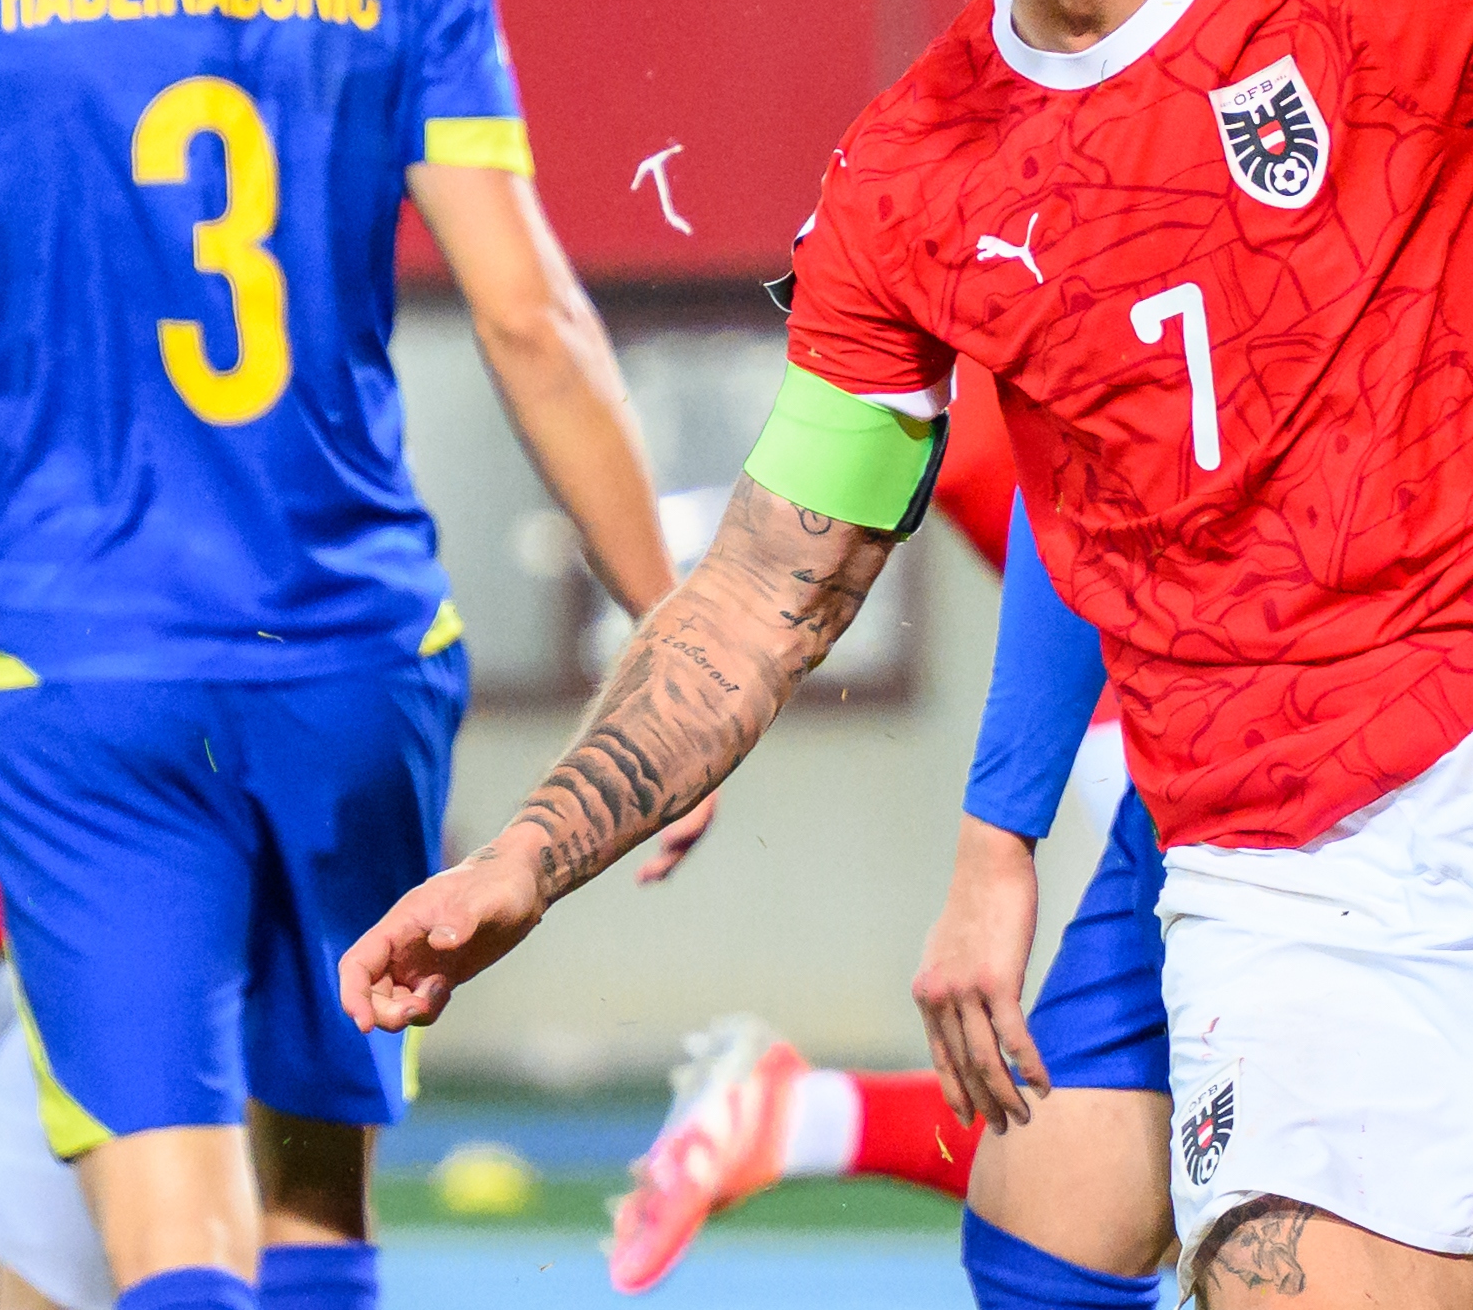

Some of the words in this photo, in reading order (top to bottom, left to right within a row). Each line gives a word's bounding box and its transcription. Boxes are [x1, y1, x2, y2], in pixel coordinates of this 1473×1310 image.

[1233, 79, 1274, 106] ÖFB
[132, 75, 293, 427] 3
[1129, 282, 1221, 471] 7
